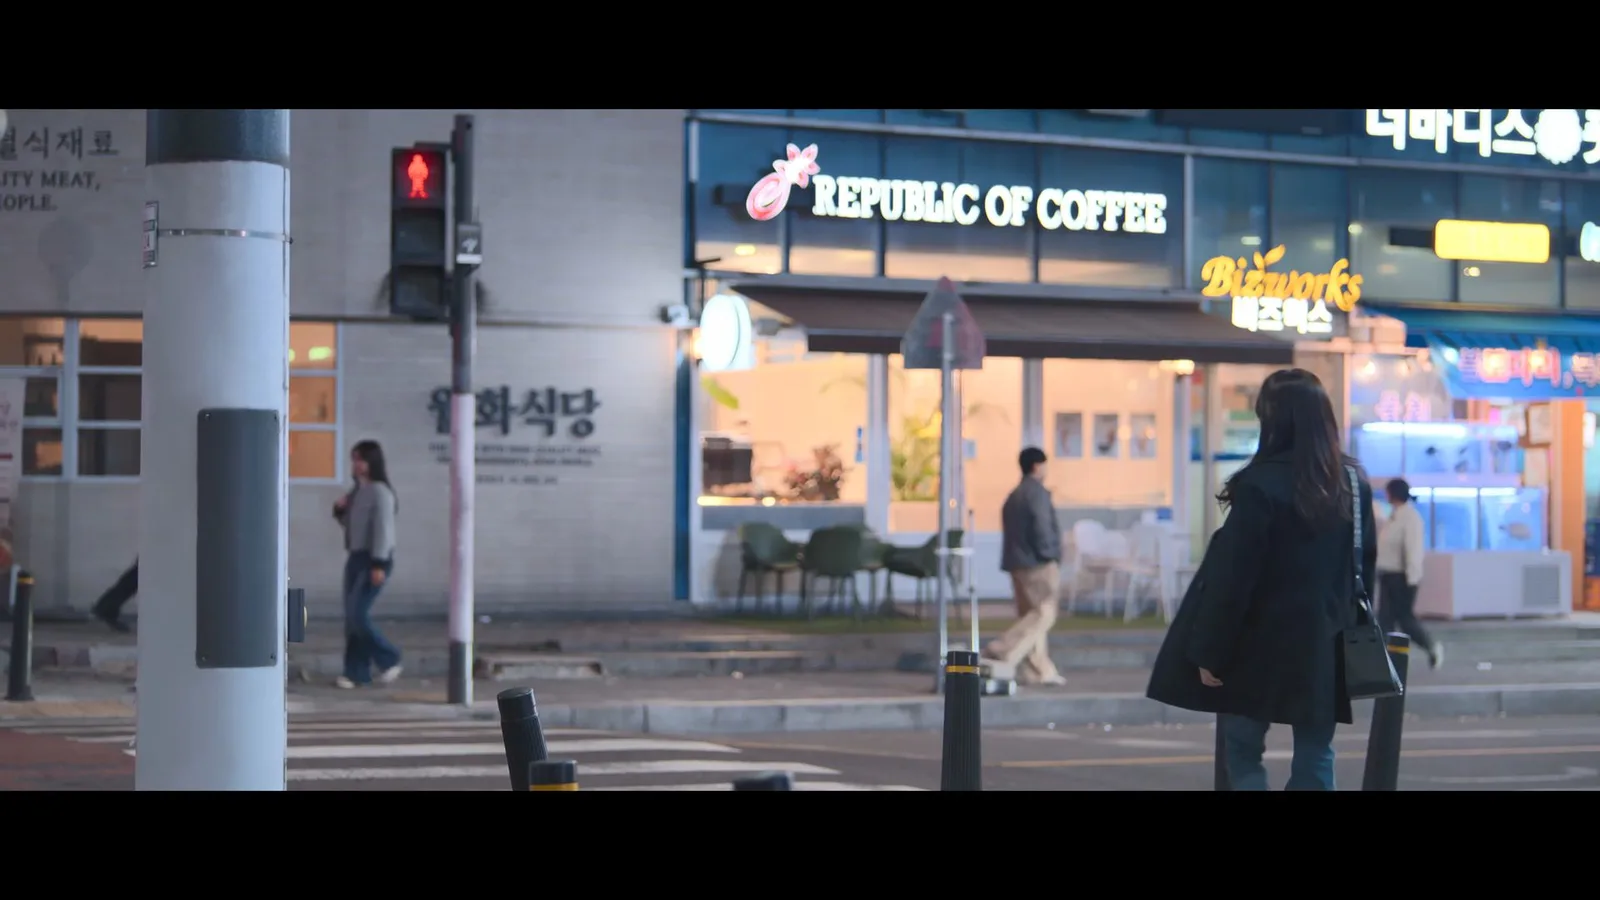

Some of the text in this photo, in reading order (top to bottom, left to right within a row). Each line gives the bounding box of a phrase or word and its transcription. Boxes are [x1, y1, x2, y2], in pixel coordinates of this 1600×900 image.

[0, 171, 100, 191] ITY MEAT,
[0, 194, 57, 211] OPLE.
[812, 174, 1167, 234] REPUBLIC OF COFFEE
[1201, 252, 1364, 312] Bizworks
